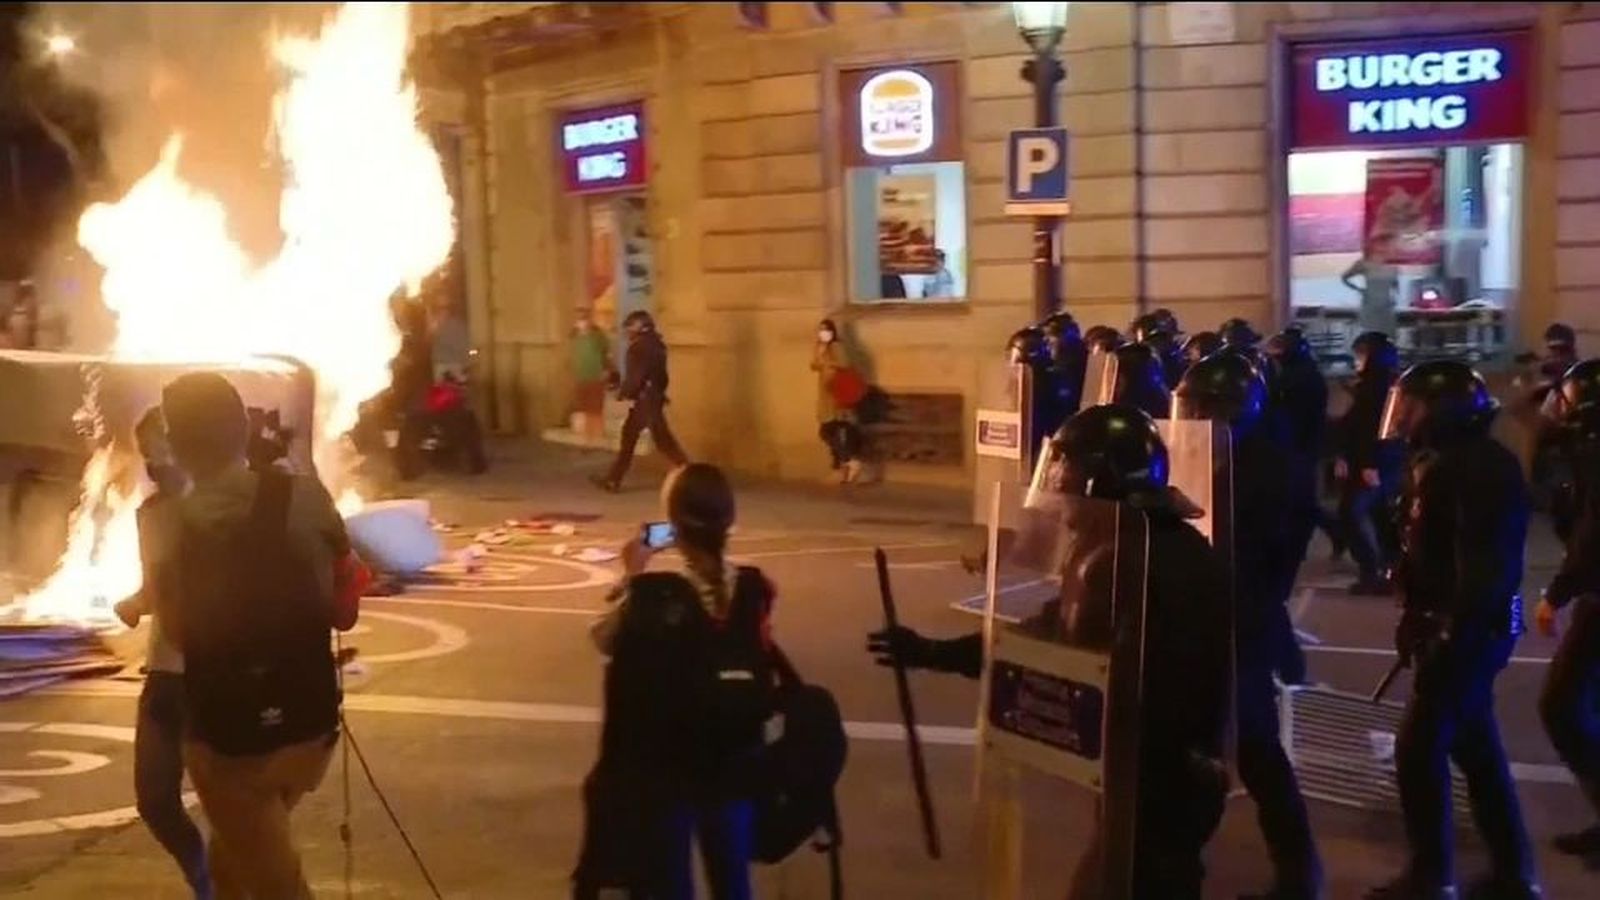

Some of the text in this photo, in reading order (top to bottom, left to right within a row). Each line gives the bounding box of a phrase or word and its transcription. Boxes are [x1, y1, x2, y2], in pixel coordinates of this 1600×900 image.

[1316, 48, 1502, 91] BURGER
[563, 114, 639, 150] GER
[1349, 95, 1467, 133] KING
[1017, 137, 1059, 193] P
